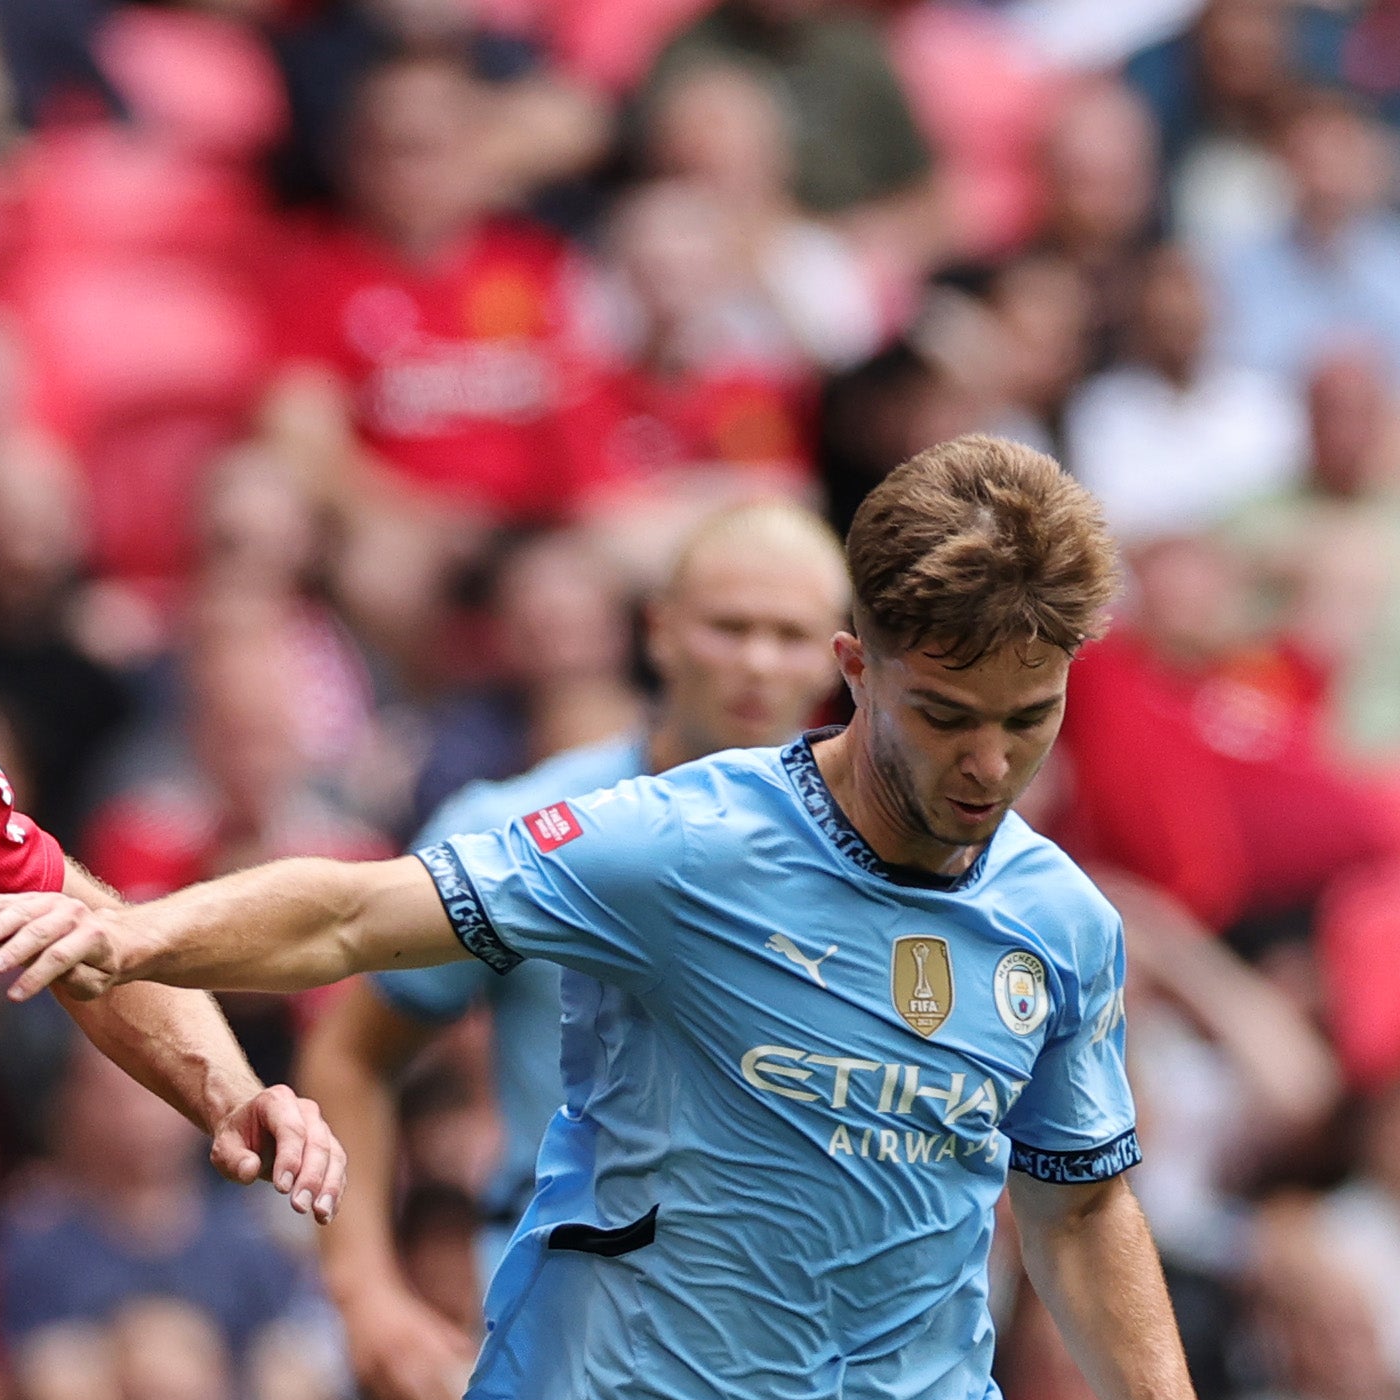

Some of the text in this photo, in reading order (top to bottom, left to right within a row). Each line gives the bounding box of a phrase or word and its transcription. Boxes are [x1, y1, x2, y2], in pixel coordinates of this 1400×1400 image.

[998, 954, 1042, 984] MANCHESTER
[910, 1001, 938, 1012] FIFA
[1013, 1022, 1031, 1032] CITY
